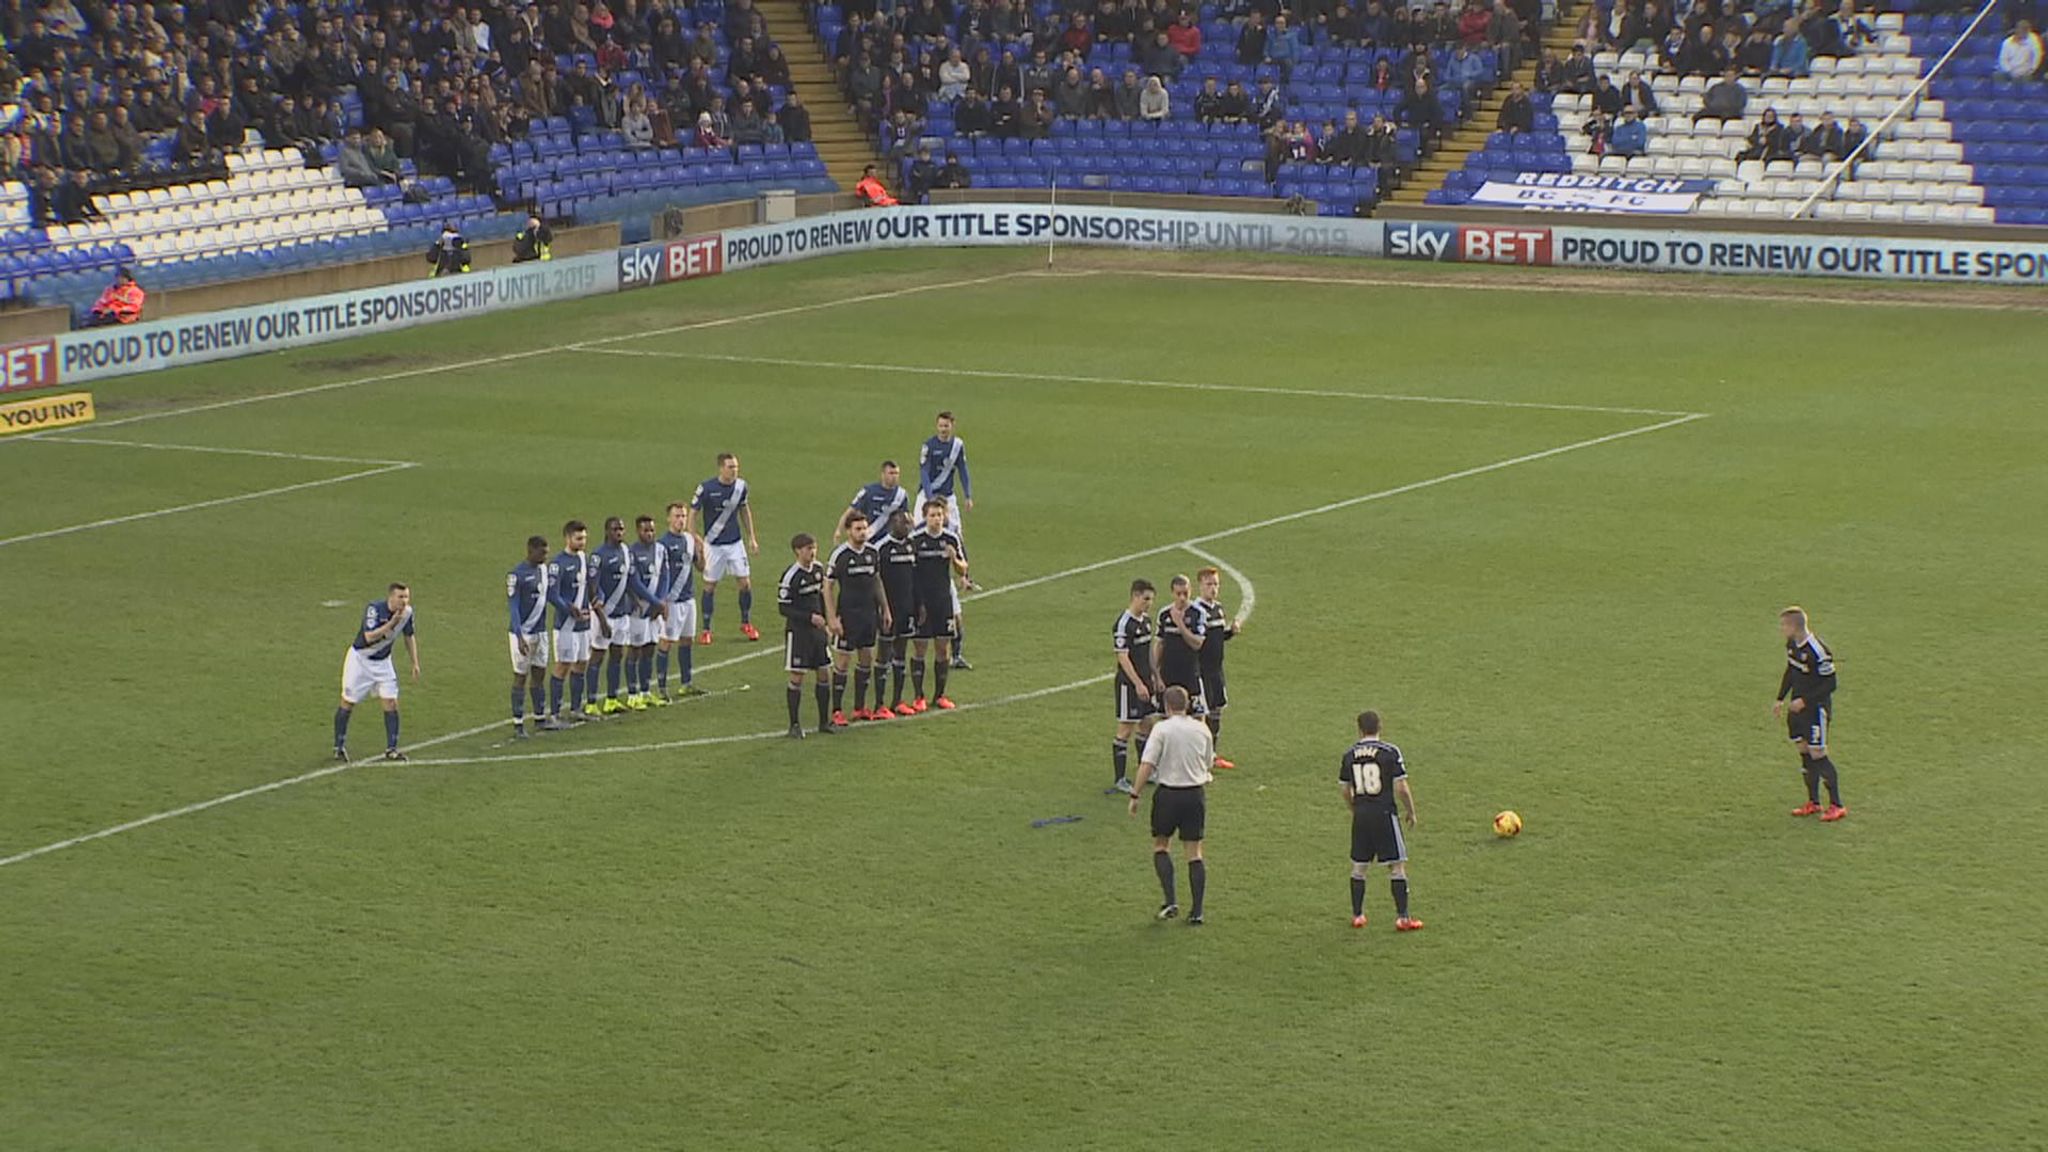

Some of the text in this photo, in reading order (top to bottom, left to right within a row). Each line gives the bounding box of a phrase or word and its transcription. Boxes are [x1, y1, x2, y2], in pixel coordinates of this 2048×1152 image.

[1515, 172, 1685, 193] REDDITCH
[622, 213, 1348, 284] sky BET PROUD TO RENEW OUR TITLE SPONSORSHIP UNTIL 2019
[1390, 224, 1450, 261] sky
[1465, 229, 1545, 264] BET
[1562, 237, 1659, 264] PROUD
[1665, 241, 1704, 266] TO
[1710, 242, 1812, 270] RENEW
[1818, 247, 1882, 273] OUR
[1888, 250, 1970, 276] TITLE
[64, 336, 140, 373] PROUD
[146, 331, 174, 358] TO
[180, 317, 252, 355] RENEW
[257, 311, 300, 342] OUR
[303, 301, 357, 334] TITLE
[361, 281, 494, 326] SPONSORSHIP
[498, 271, 550, 301] UNTIL
[554, 264, 598, 293] 2019
[0, 400, 87, 427] YOU IN?
[1352, 763, 1382, 795] 18
